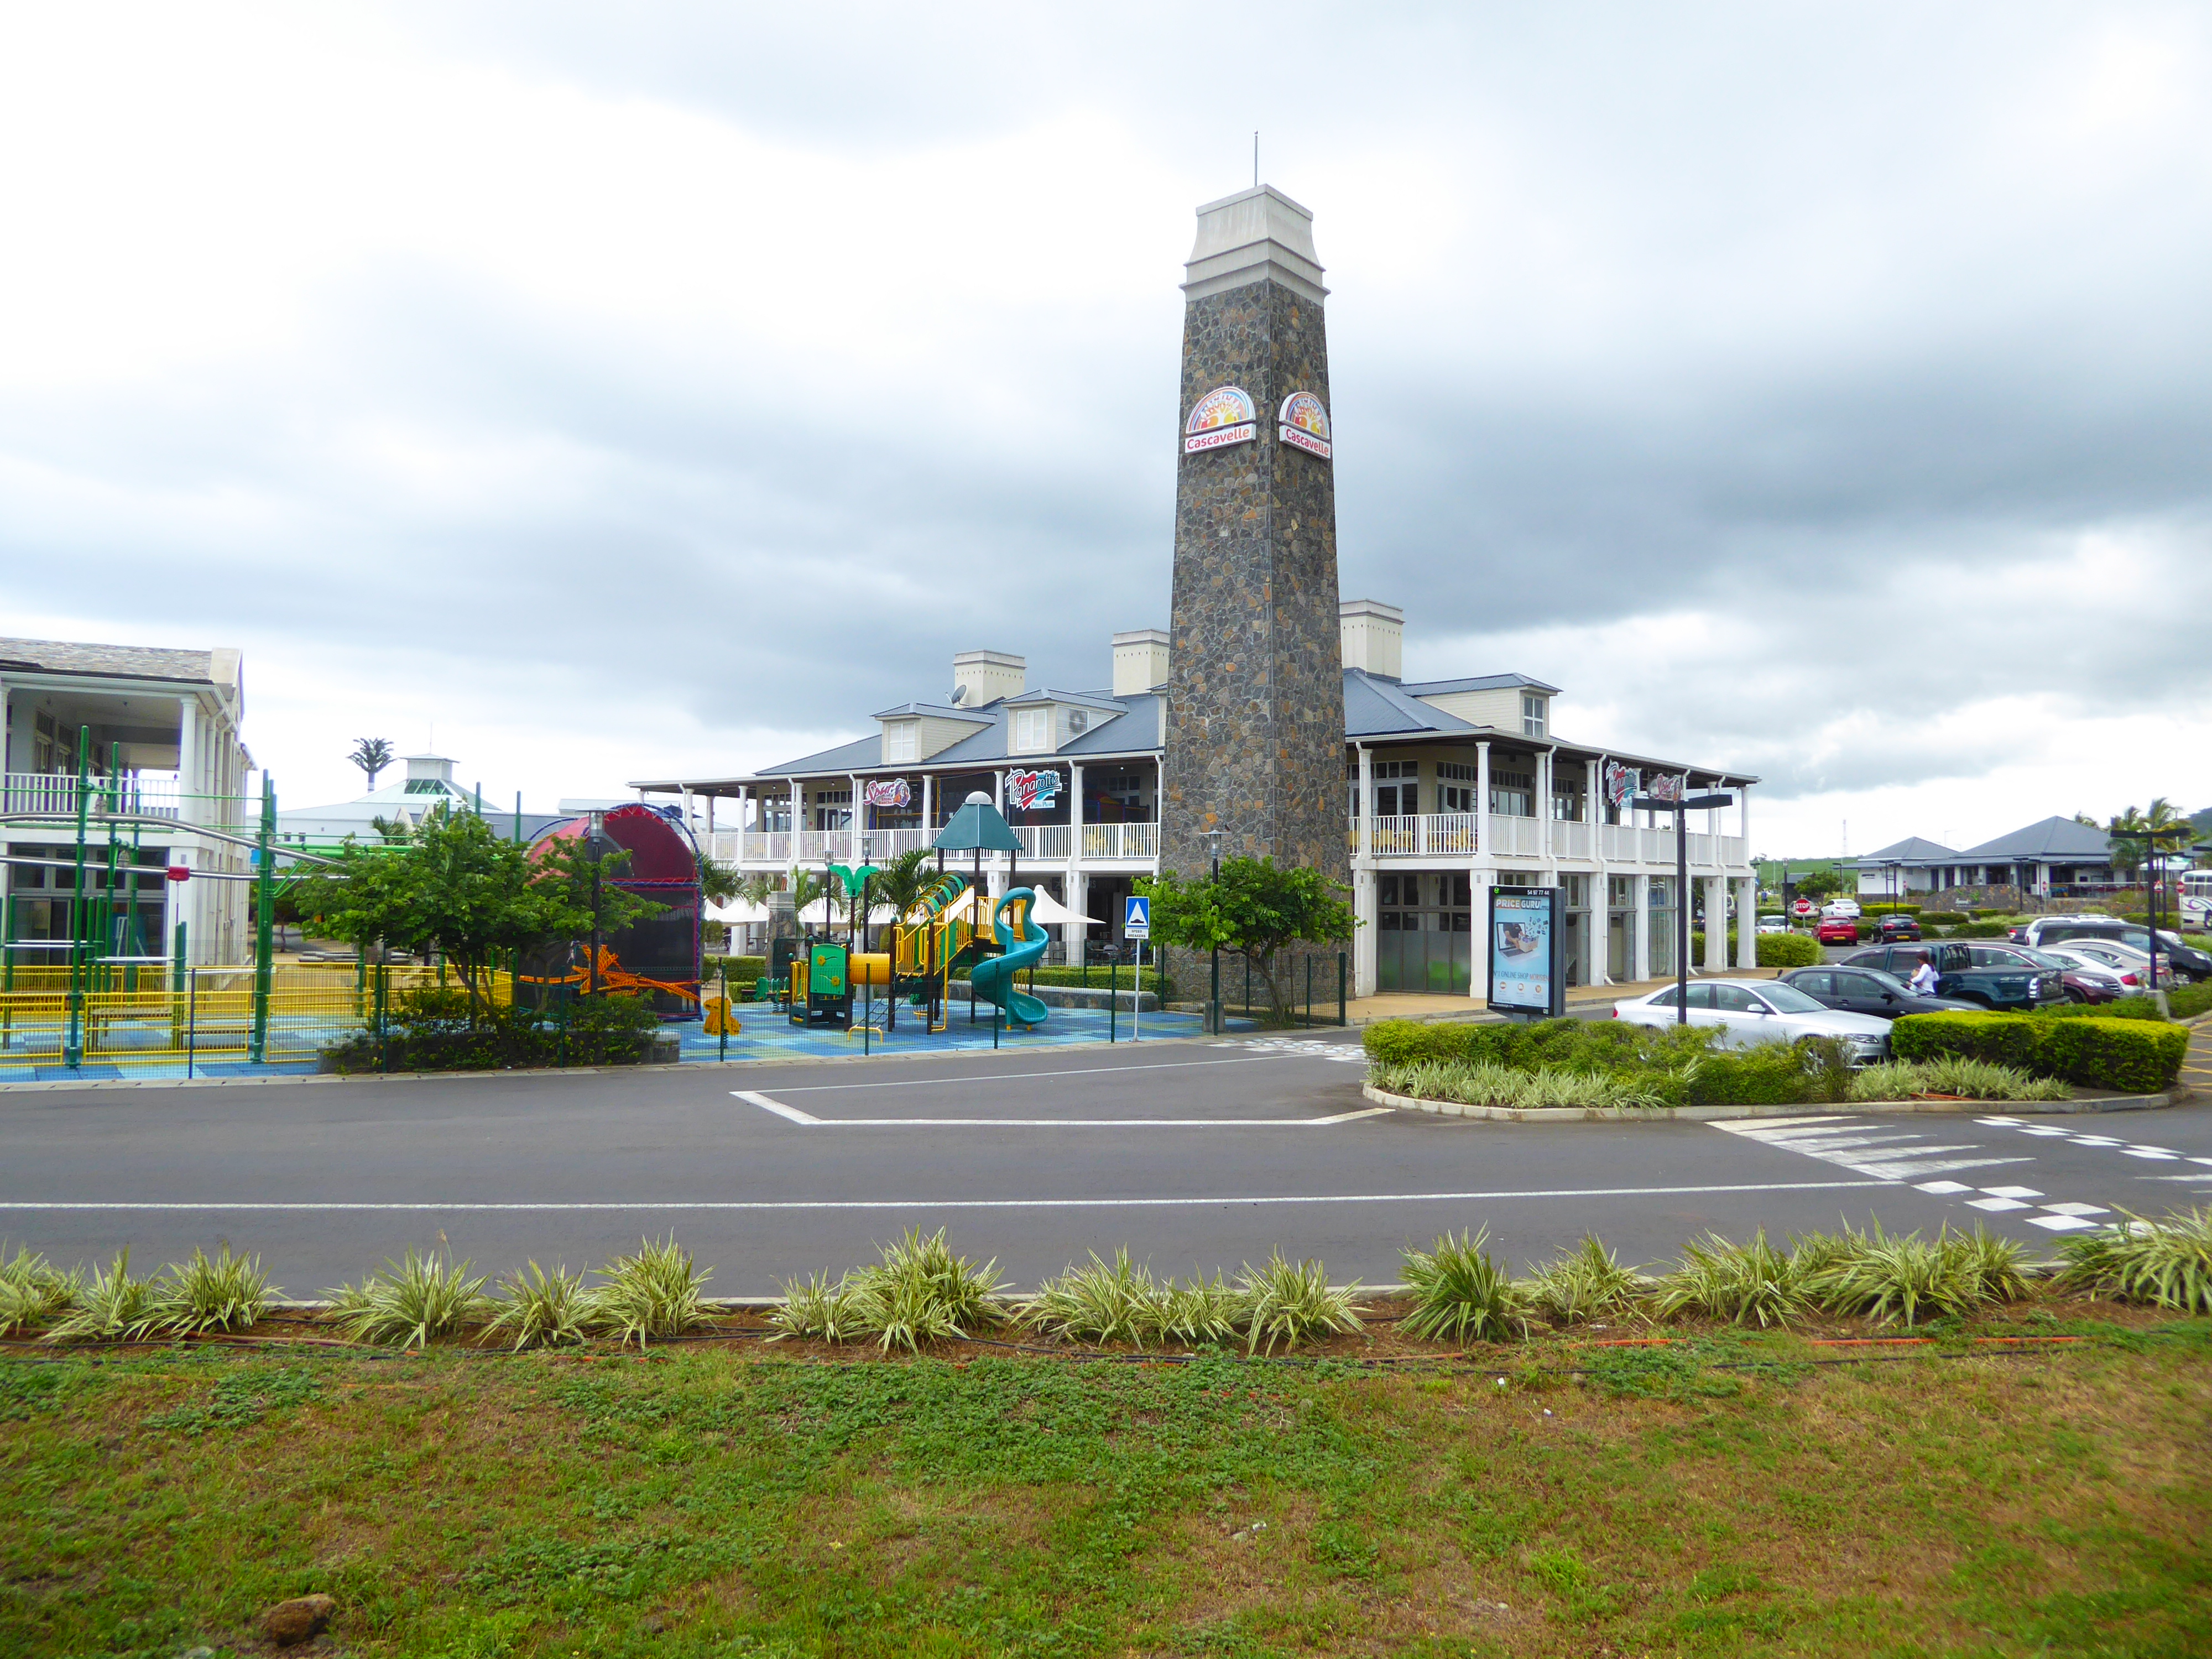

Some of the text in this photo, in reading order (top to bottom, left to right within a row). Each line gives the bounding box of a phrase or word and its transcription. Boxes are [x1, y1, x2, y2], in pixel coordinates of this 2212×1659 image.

[1187, 427, 1250, 450] Cascavelle
[1286, 428, 1329, 456] Cascavelle
[863, 781, 895, 805] Spur
[1006, 771, 1059, 802] Panarottis
[1496, 899, 1520, 907] PRICE
[1521, 900, 1540, 909] GURU
